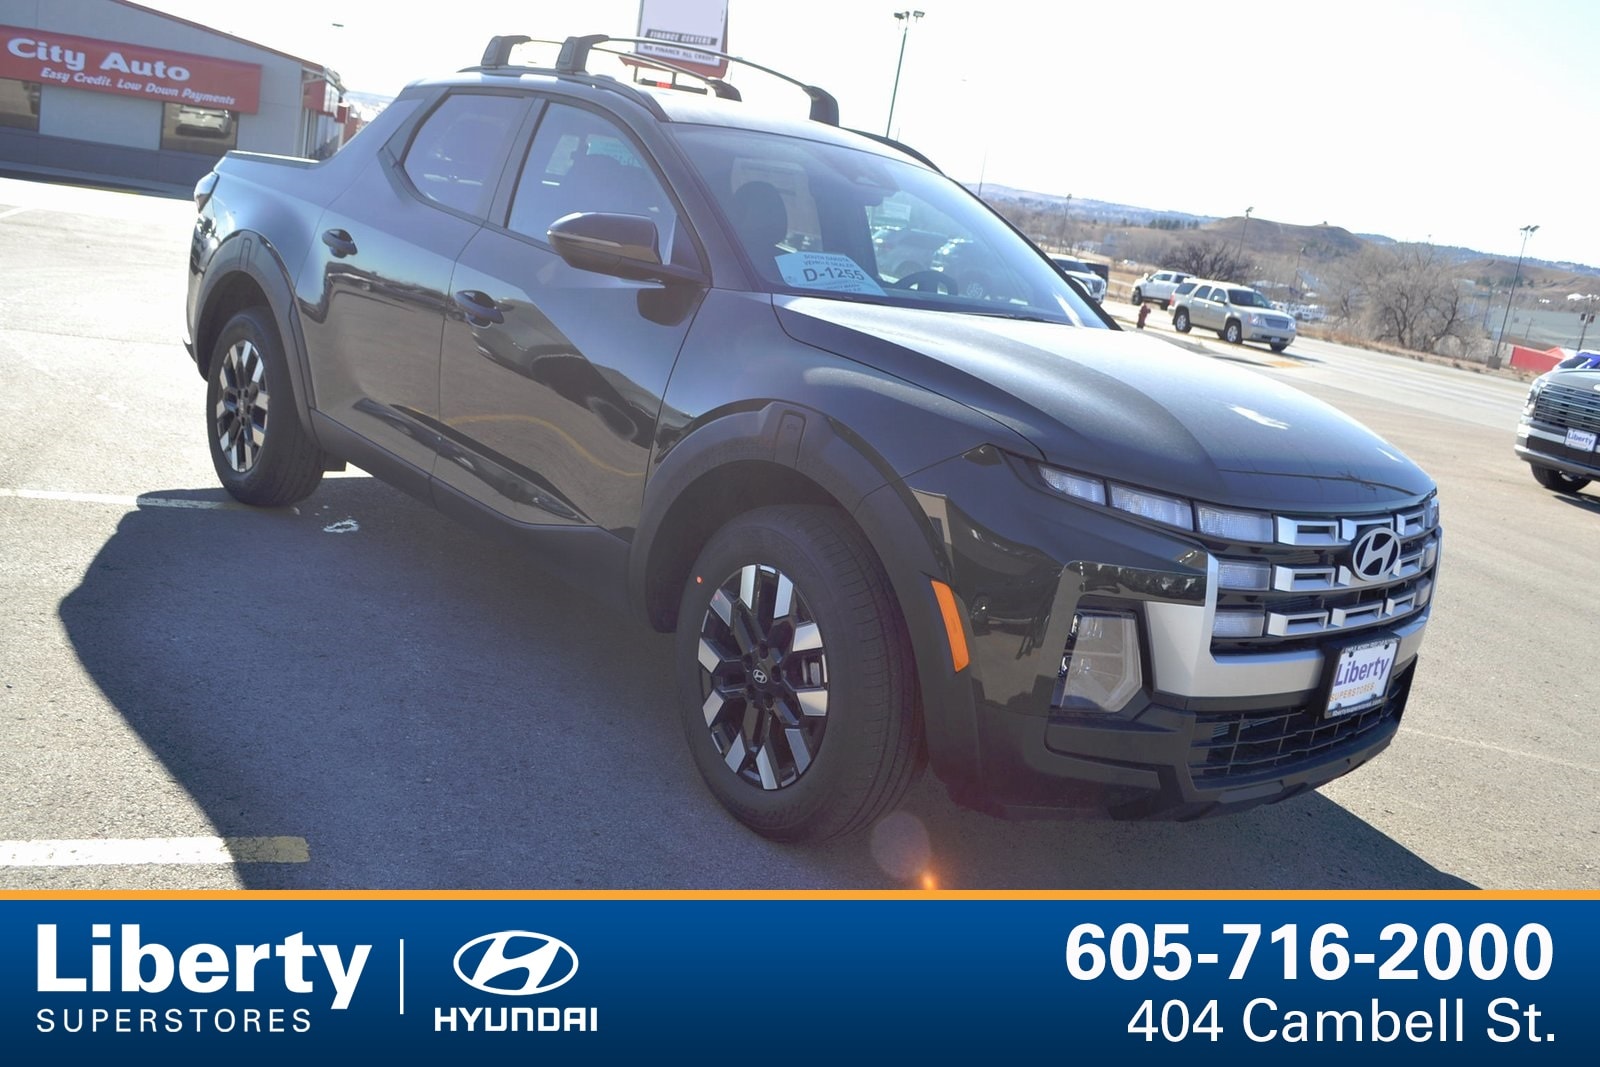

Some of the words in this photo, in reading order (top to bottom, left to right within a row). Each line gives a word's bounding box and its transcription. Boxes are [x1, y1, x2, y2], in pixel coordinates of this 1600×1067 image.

[7, 38, 86, 71] City
[99, 52, 190, 81] Auto
[41, 68, 70, 84] Easy
[117, 79, 142, 91] Low
[145, 82, 178, 97] Down
[182, 88, 235, 105] Payments
[803, 267, 864, 282] D-1255
[1567, 432, 1593, 445] Liberty
[1335, 656, 1390, 687] Liberty
